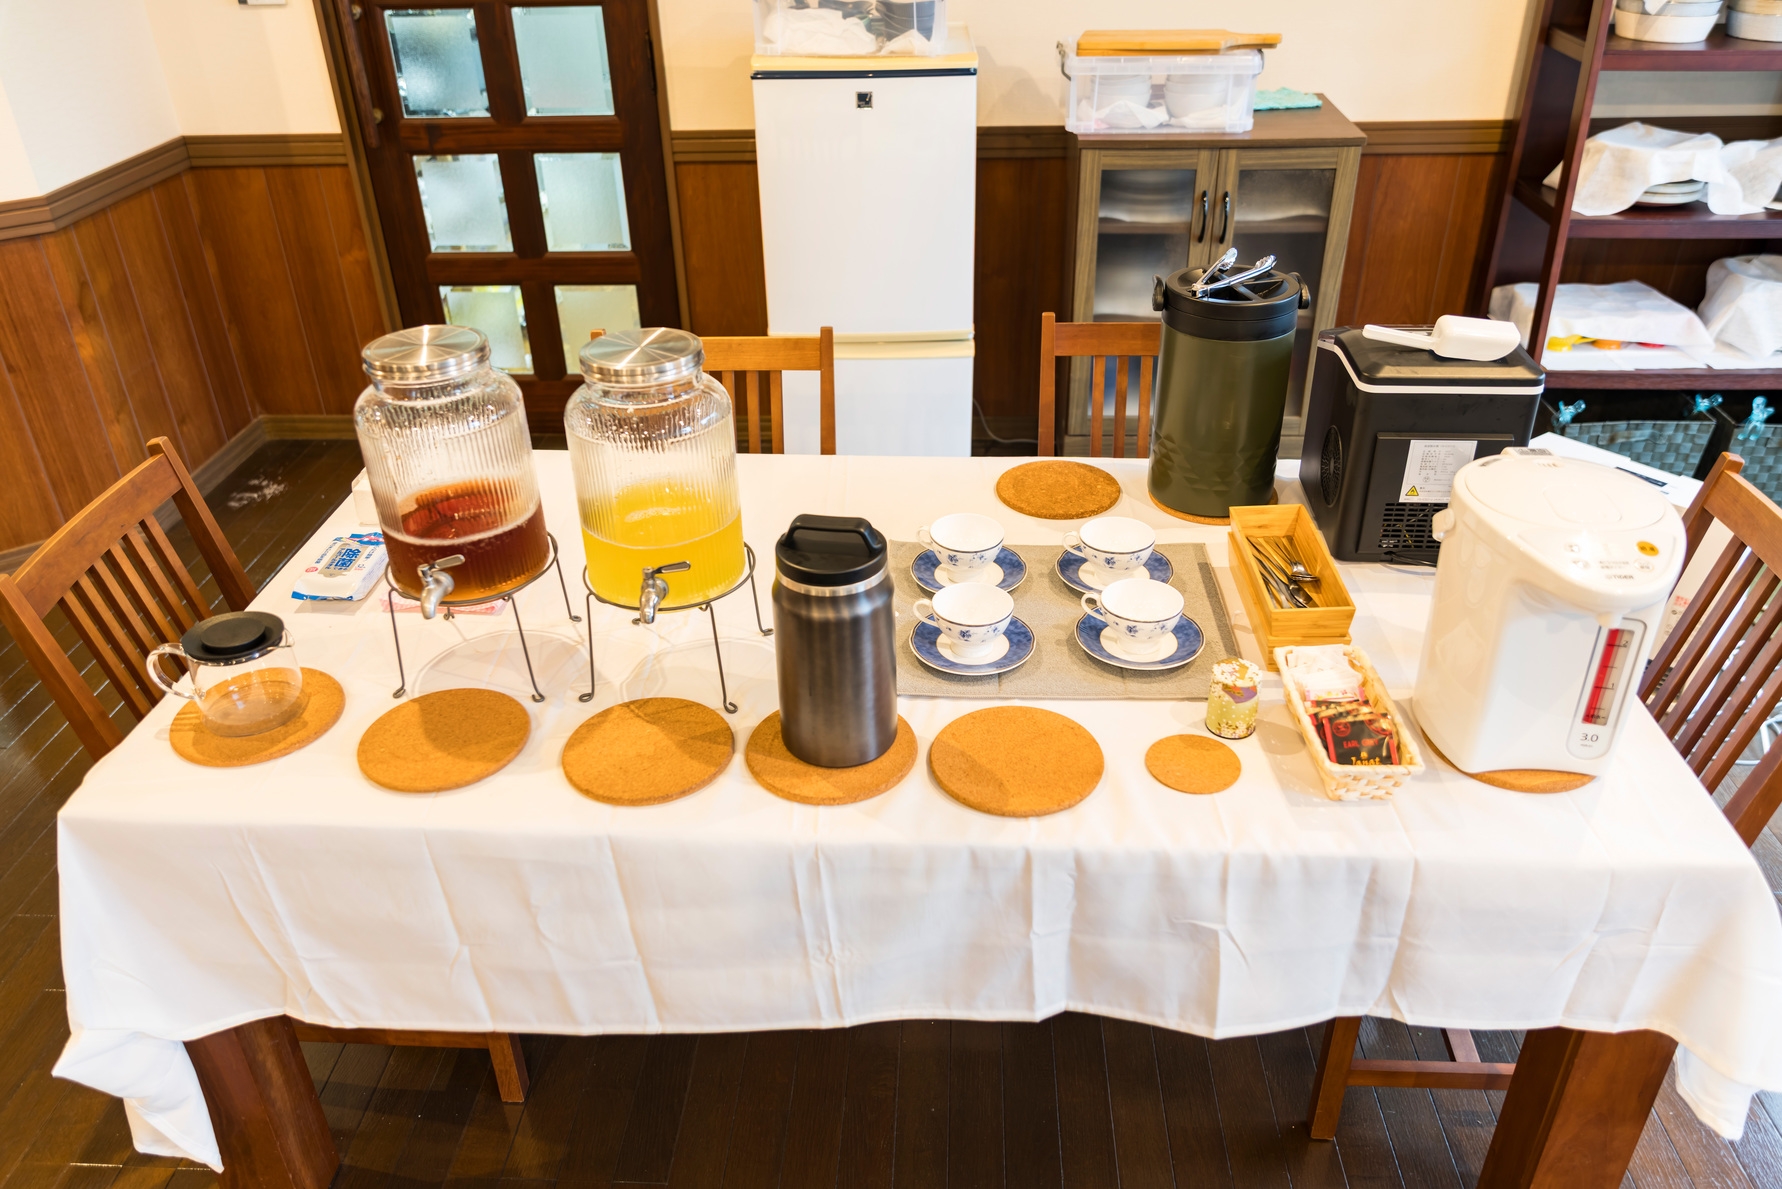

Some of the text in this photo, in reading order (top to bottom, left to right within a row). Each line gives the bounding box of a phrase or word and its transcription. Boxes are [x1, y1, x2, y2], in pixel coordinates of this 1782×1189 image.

[335, 548, 361, 568] 除菌
[1580, 732, 1599, 743] 3.0
[1342, 739, 1360, 749] EARL
